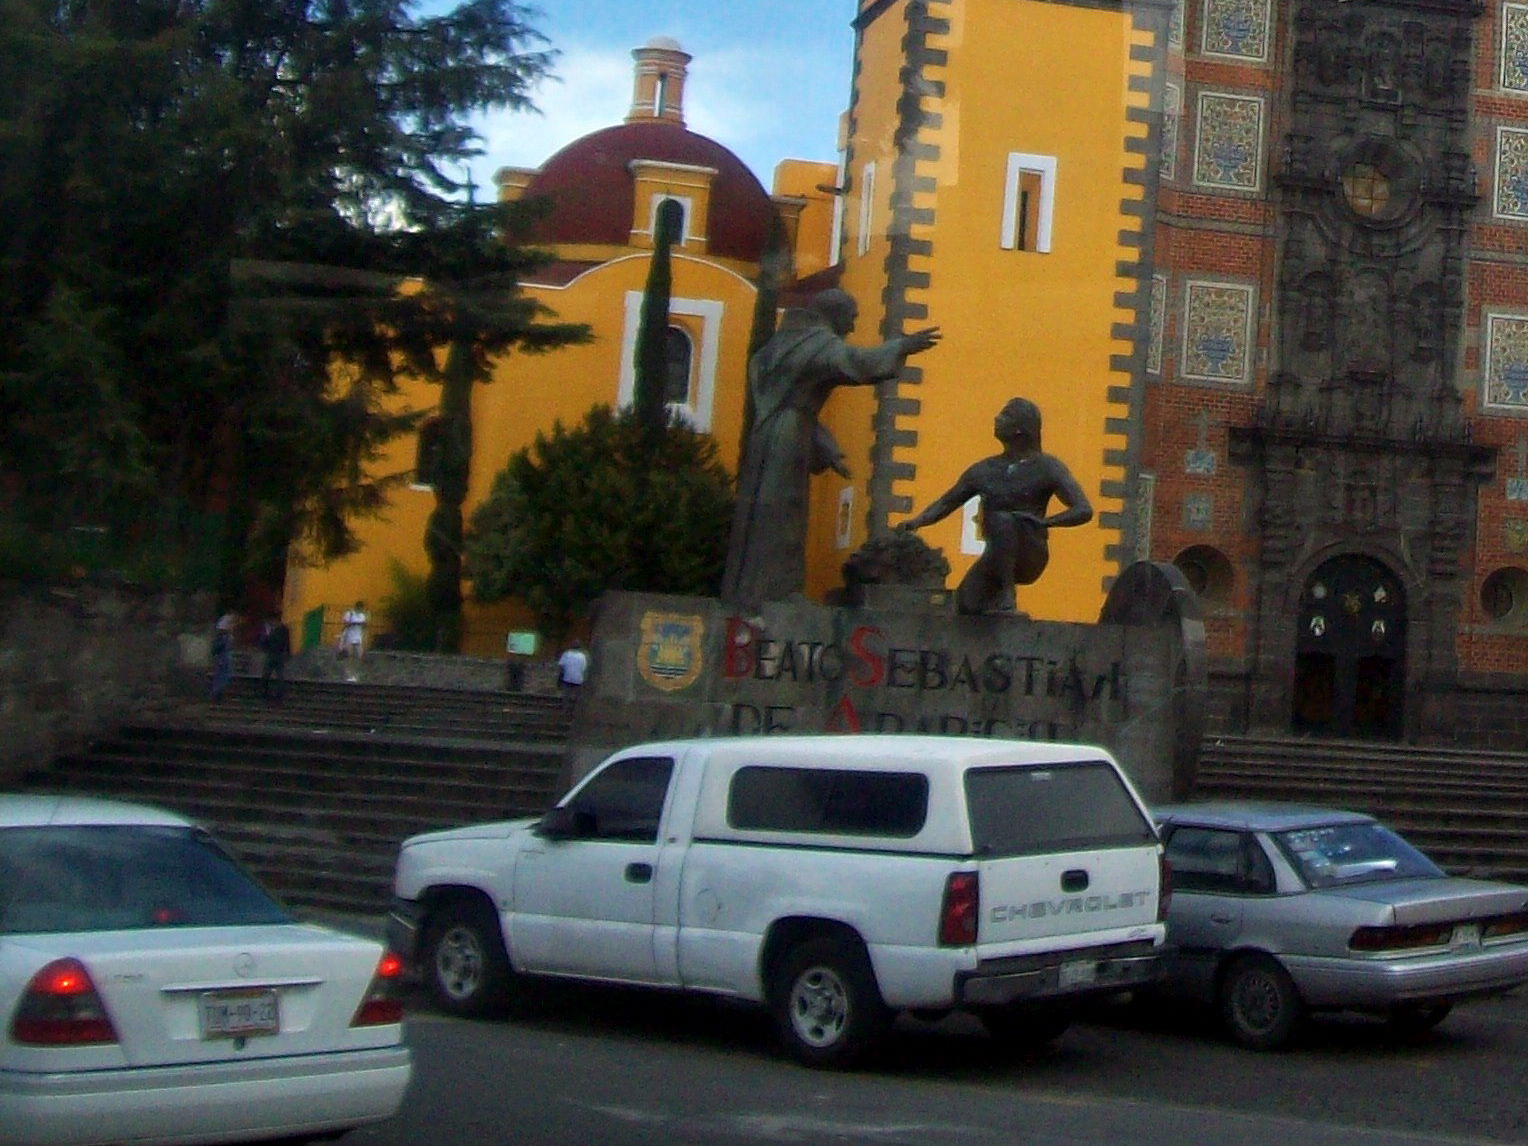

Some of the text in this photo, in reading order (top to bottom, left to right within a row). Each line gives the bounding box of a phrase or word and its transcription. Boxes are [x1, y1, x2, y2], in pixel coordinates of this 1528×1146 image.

[723, 615, 841, 682] BEATO
[732, 703, 793, 735] DE
[990, 891, 1150, 923] CHEVROLET
